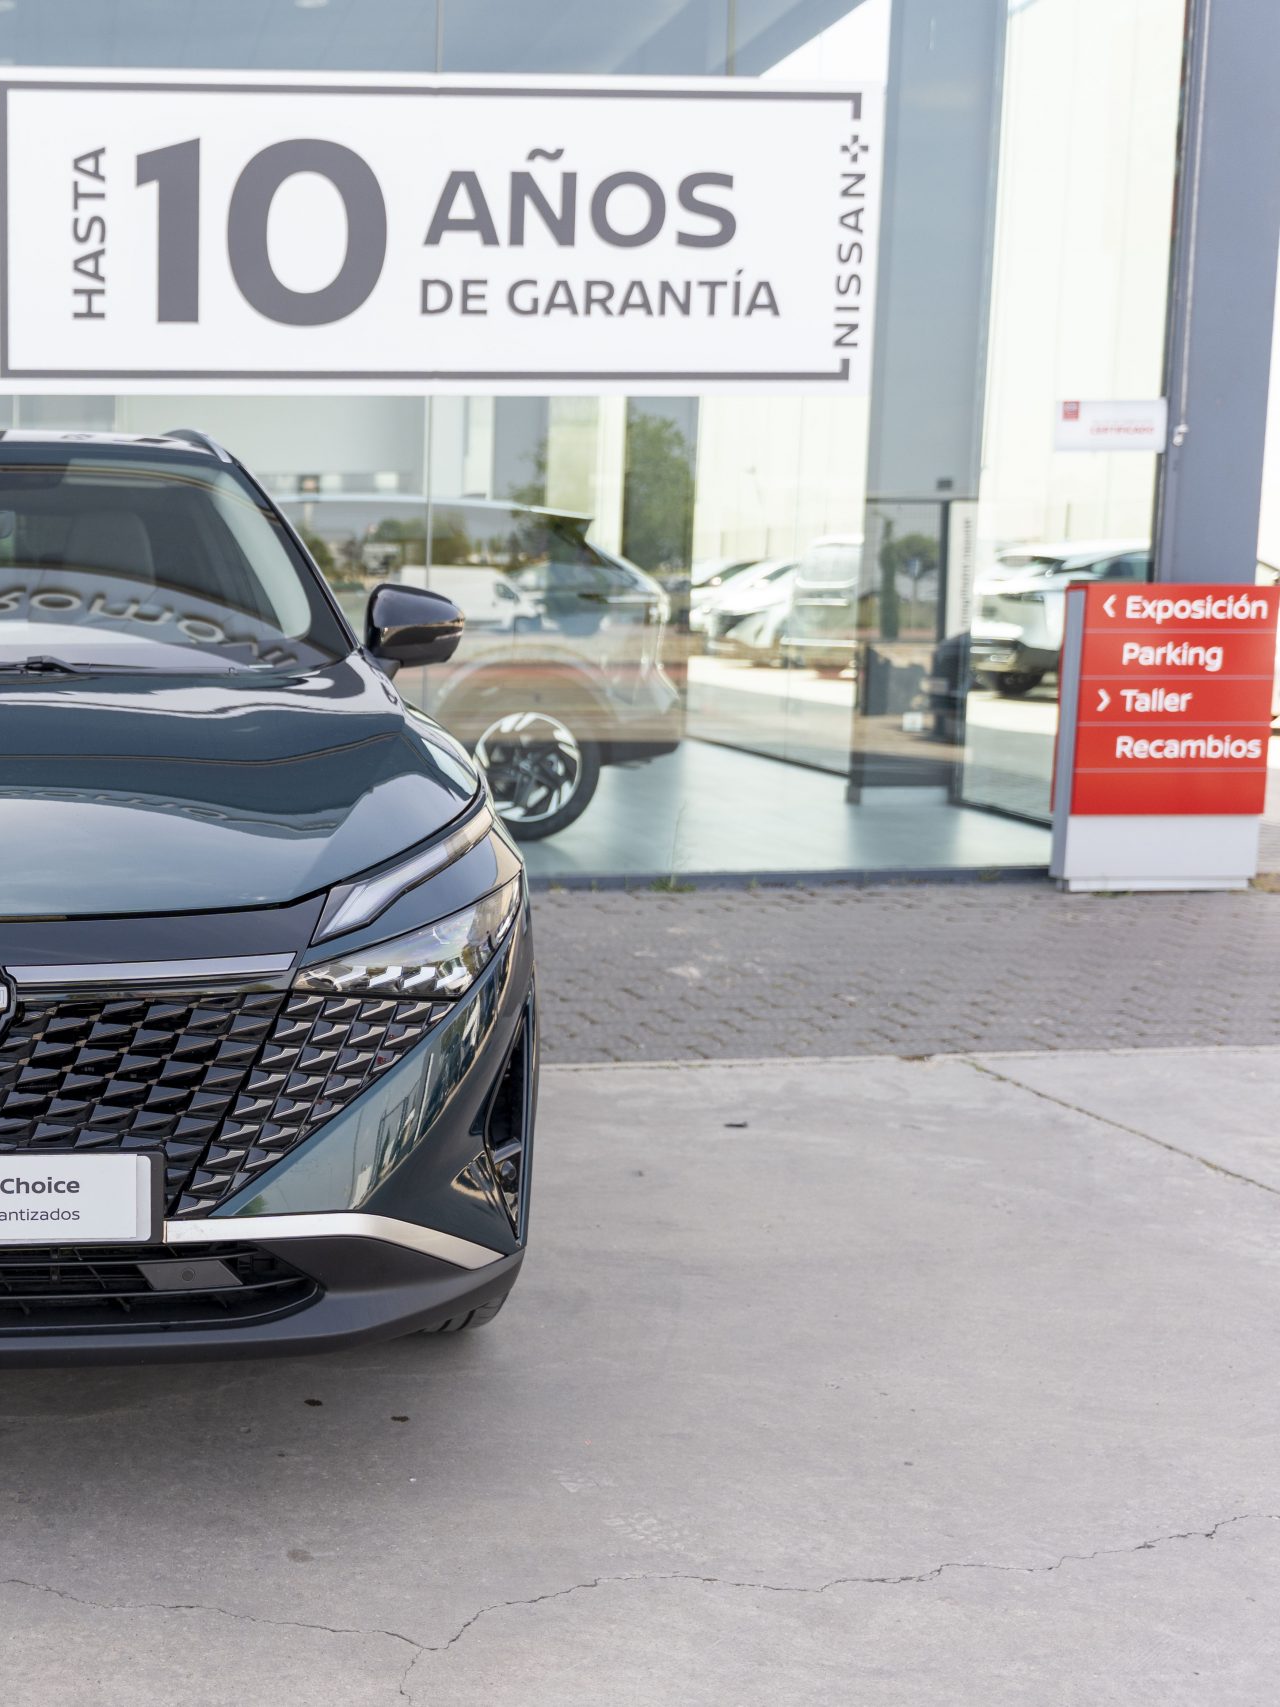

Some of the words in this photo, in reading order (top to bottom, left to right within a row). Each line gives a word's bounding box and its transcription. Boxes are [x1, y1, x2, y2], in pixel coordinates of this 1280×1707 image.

[423, 148, 738, 249] AÑOS
[73, 147, 106, 320] HASTA
[135, 137, 388, 327] 10
[833, 172, 867, 347] NISSAN
[420, 279, 488, 317] DE
[507, 268, 781, 318] GARANTÍA
[1125, 593, 1269, 625] Exposición
[1122, 641, 1224, 673] Parking
[1120, 687, 1193, 713] Taller
[1116, 734, 1262, 760] Recambios
[0, 1176, 81, 1195] Choice
